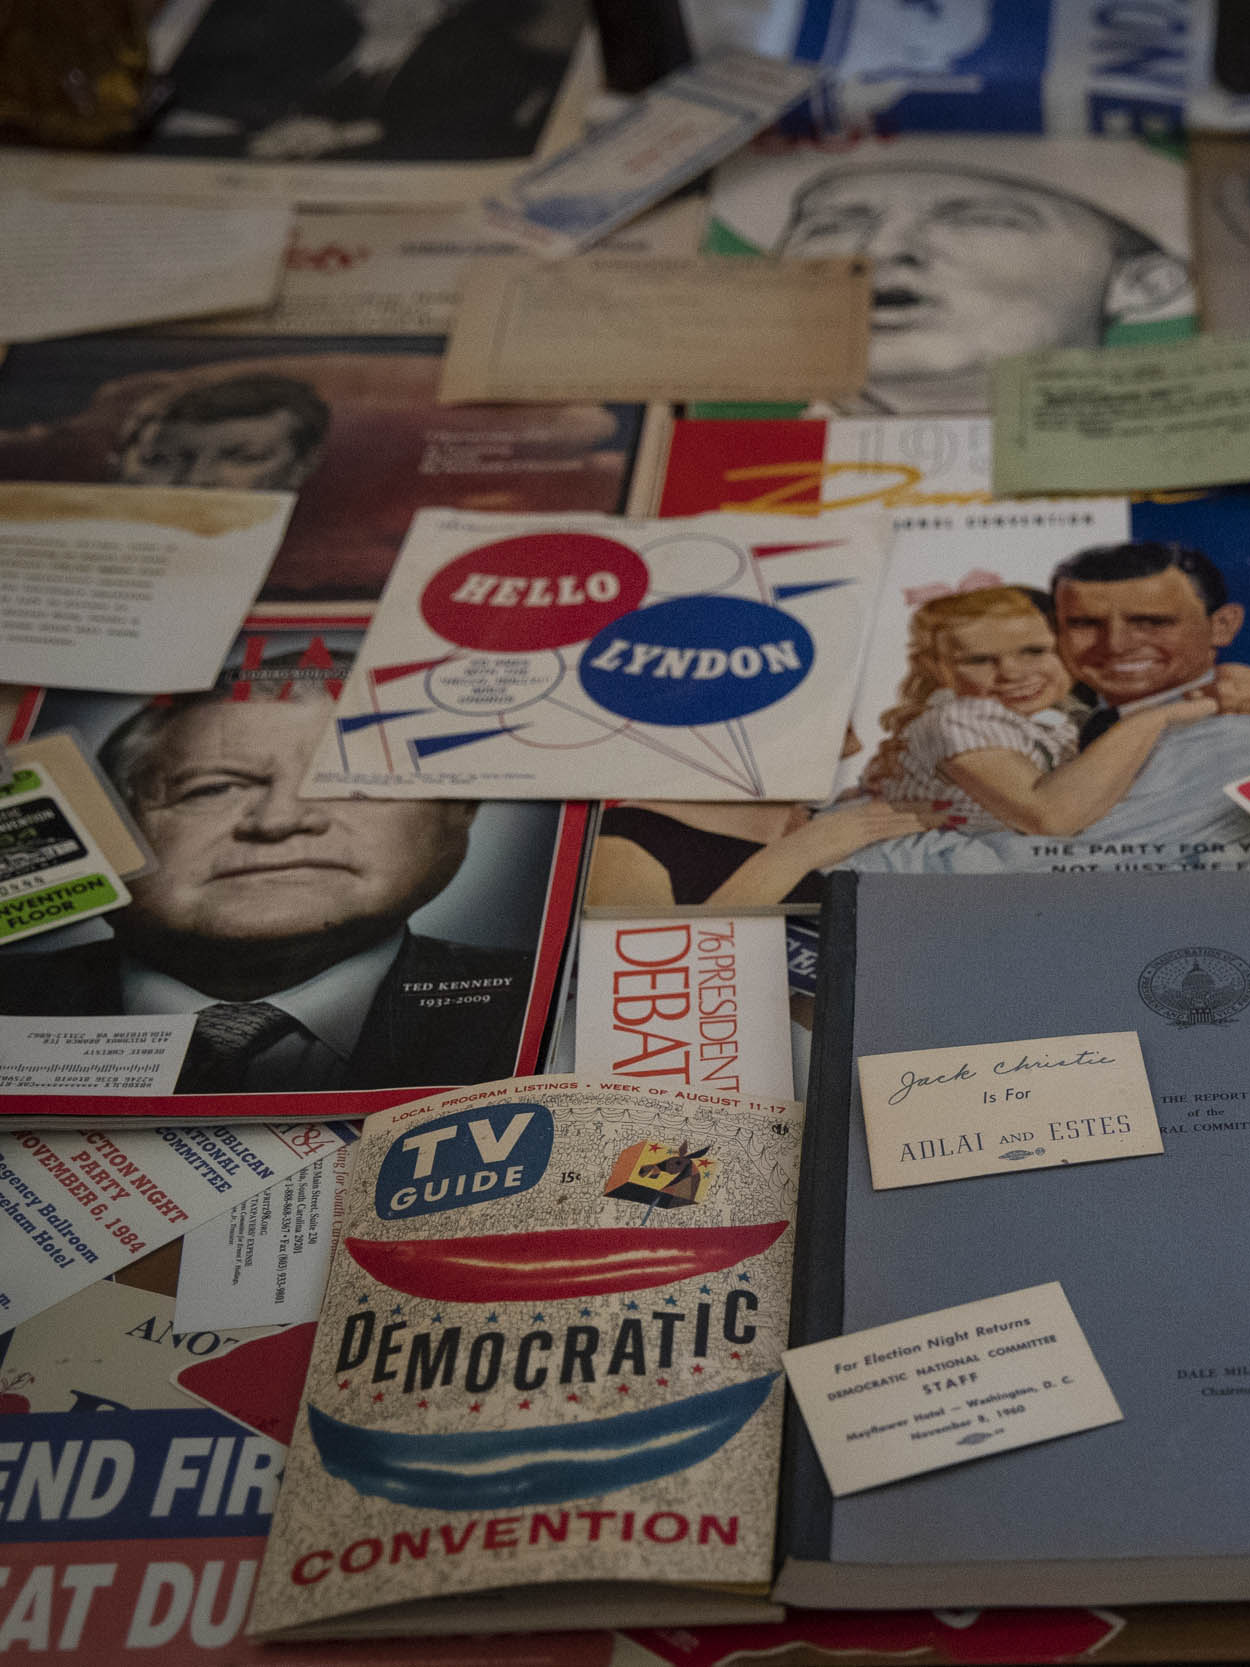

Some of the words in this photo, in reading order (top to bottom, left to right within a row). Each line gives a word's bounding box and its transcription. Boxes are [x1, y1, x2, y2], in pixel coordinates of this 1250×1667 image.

[965, 513, 1095, 529] CONVENTION
[451, 570, 622, 608] HELLO
[591, 638, 802, 681] LYNDON
[1032, 845, 1075, 857] THE
[1089, 843, 1166, 855] PARTY
[1179, 842, 1226, 854] FOR
[1051, 864, 1098, 873] NOT
[1114, 863, 1171, 873] JUST
[1181, 862, 1227, 872] THE
[8, 901, 75, 929] FLOOR
[403, 982, 434, 992] TED
[438, 977, 513, 991] KENNEDY
[419, 995, 491, 1008] 1932-2009
[612, 924, 691, 1085] DEBAT
[698, 955, 741, 1093] PRESIDENT
[888, 1063, 977, 1105] Jack
[993, 1050, 1116, 1076] Christie
[983, 1090, 996, 1104] Is
[1005, 1088, 1031, 1101] For
[392, 1109, 438, 1123] LOCAL
[441, 1088, 508, 1109] PROGRAM
[514, 1082, 579, 1095] LISTINGS
[600, 1083, 641, 1094] WEEK
[649, 1088, 669, 1097] OF
[675, 1090, 740, 1108] AUGUST
[749, 1103, 787, 1114] 11-17
[1160, 1094, 1188, 1104] THE
[1194, 1092, 1249, 1102] REPORT
[1187, 1109, 1200, 1118] of
[1206, 1108, 1225, 1117] the
[212, 1124, 275, 1180] UBLICAN
[402, 1112, 536, 1179] TV
[900, 1132, 985, 1162] ADLAI
[999, 1131, 1035, 1145] AND
[1047, 1114, 1132, 1142] ESTES
[72, 1151, 131, 1201] PARTY
[155, 1127, 232, 1194] COMMITTEE
[11, 1130, 99, 1209] NOVEMBER
[90, 1203, 110, 1222] 6,
[105, 1217, 148, 1255] 1984
[130, 1173, 189, 1224] NIGHT
[297, 1183, 307, 1203] South
[312, 1171, 322, 1190] Main
[390, 1165, 525, 1211] GUIDE
[295, 1204, 305, 1233] Carolina
[310, 1191, 321, 1213] Street,
[333, 1187, 348, 1218] South
[38, 1203, 100, 1264] Ballroom
[309, 1214, 319, 1231] Suite
[32, 1230, 76, 1269] Hotel
[244, 1238, 256, 1267] EXPENSE
[279, 1239, 289, 1253] Fax
[293, 1234, 303, 1254] 29201
[336, 1289, 759, 1393] DEMOCRATIC
[834, 1360, 859, 1375] For
[864, 1343, 922, 1367] Election
[927, 1330, 970, 1350] Night
[975, 1316, 1032, 1336] Returns
[827, 1371, 908, 1401] DEMOCRATIC
[916, 1354, 980, 1377] NATIONAL
[988, 1334, 1057, 1358] COMMITTEE
[923, 1372, 979, 1395] STAFF
[1177, 1368, 1217, 1380] DALE
[152, 1436, 285, 1517] FIR
[291, 1512, 739, 1586] CONVENTION
[0, 1563, 118, 1650] AT
[125, 1560, 258, 1648] DU
